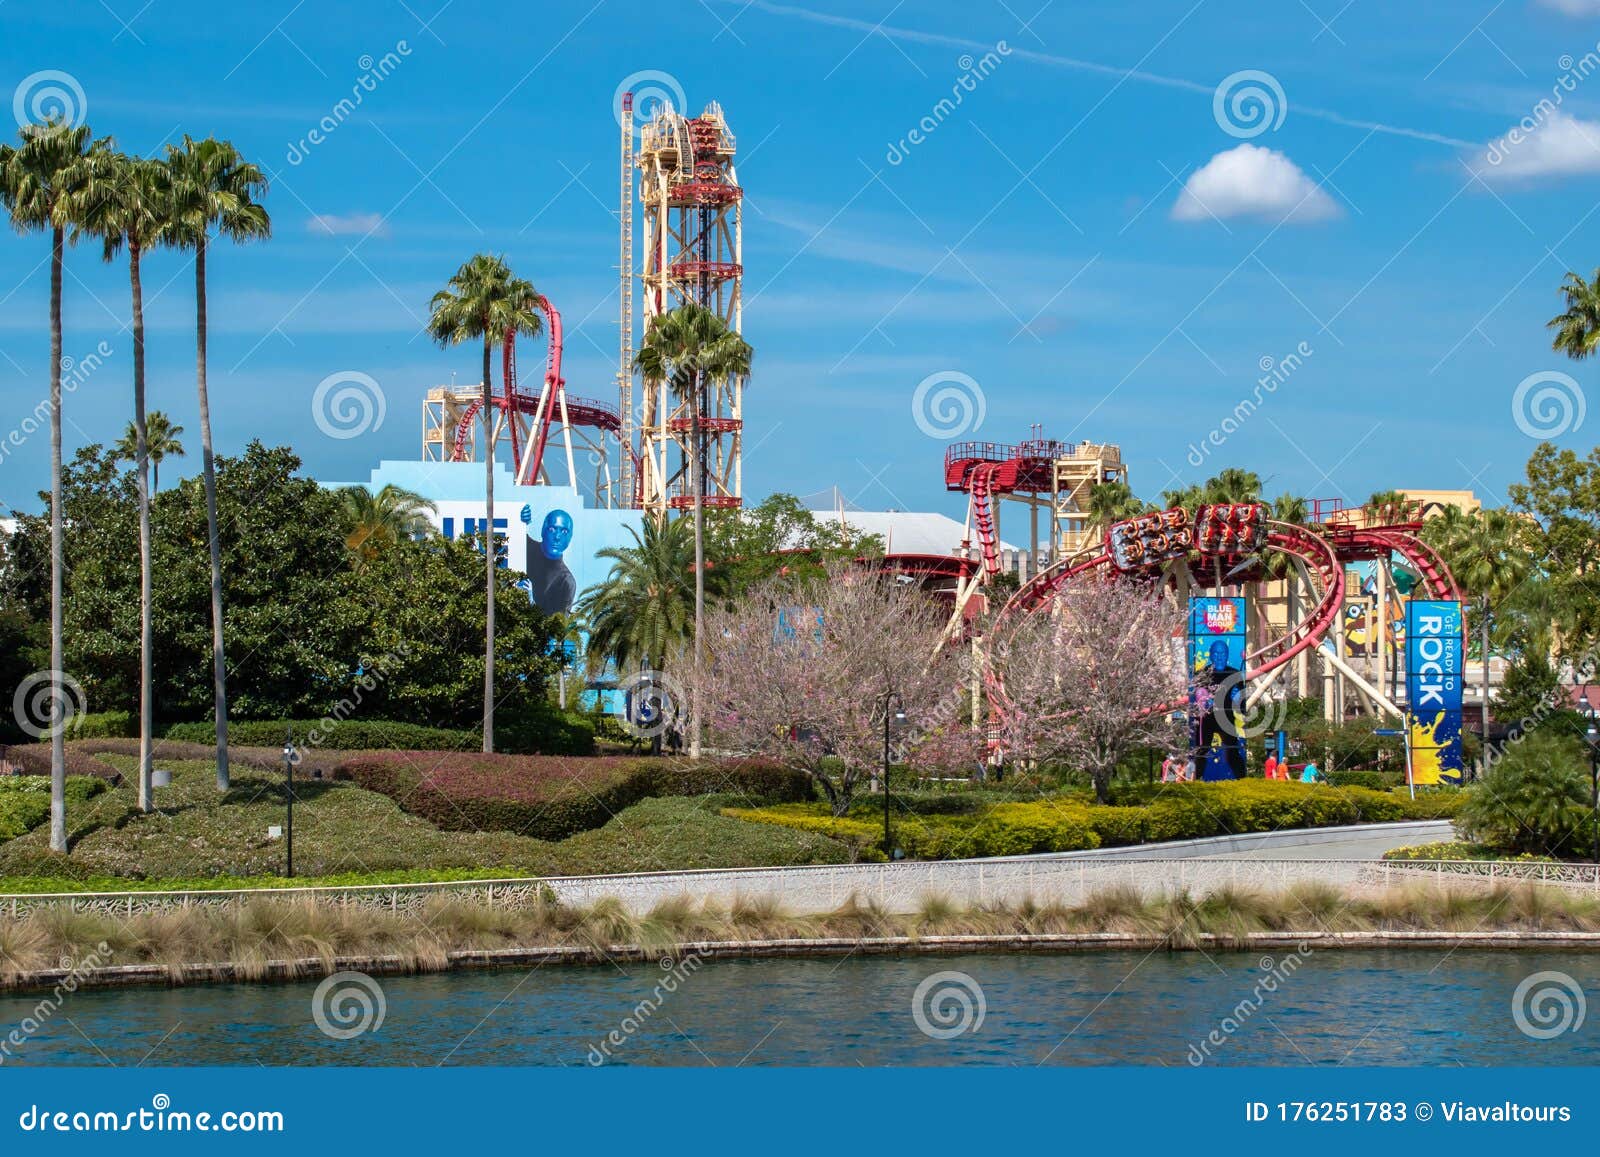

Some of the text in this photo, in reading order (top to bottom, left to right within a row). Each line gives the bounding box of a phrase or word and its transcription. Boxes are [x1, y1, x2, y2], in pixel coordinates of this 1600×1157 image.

[1207, 605, 1232, 613] BLUE
[1207, 613, 1233, 621] MAN
[1419, 616, 1443, 705] ROCK
[1444, 615, 1454, 691] GET READY TO
